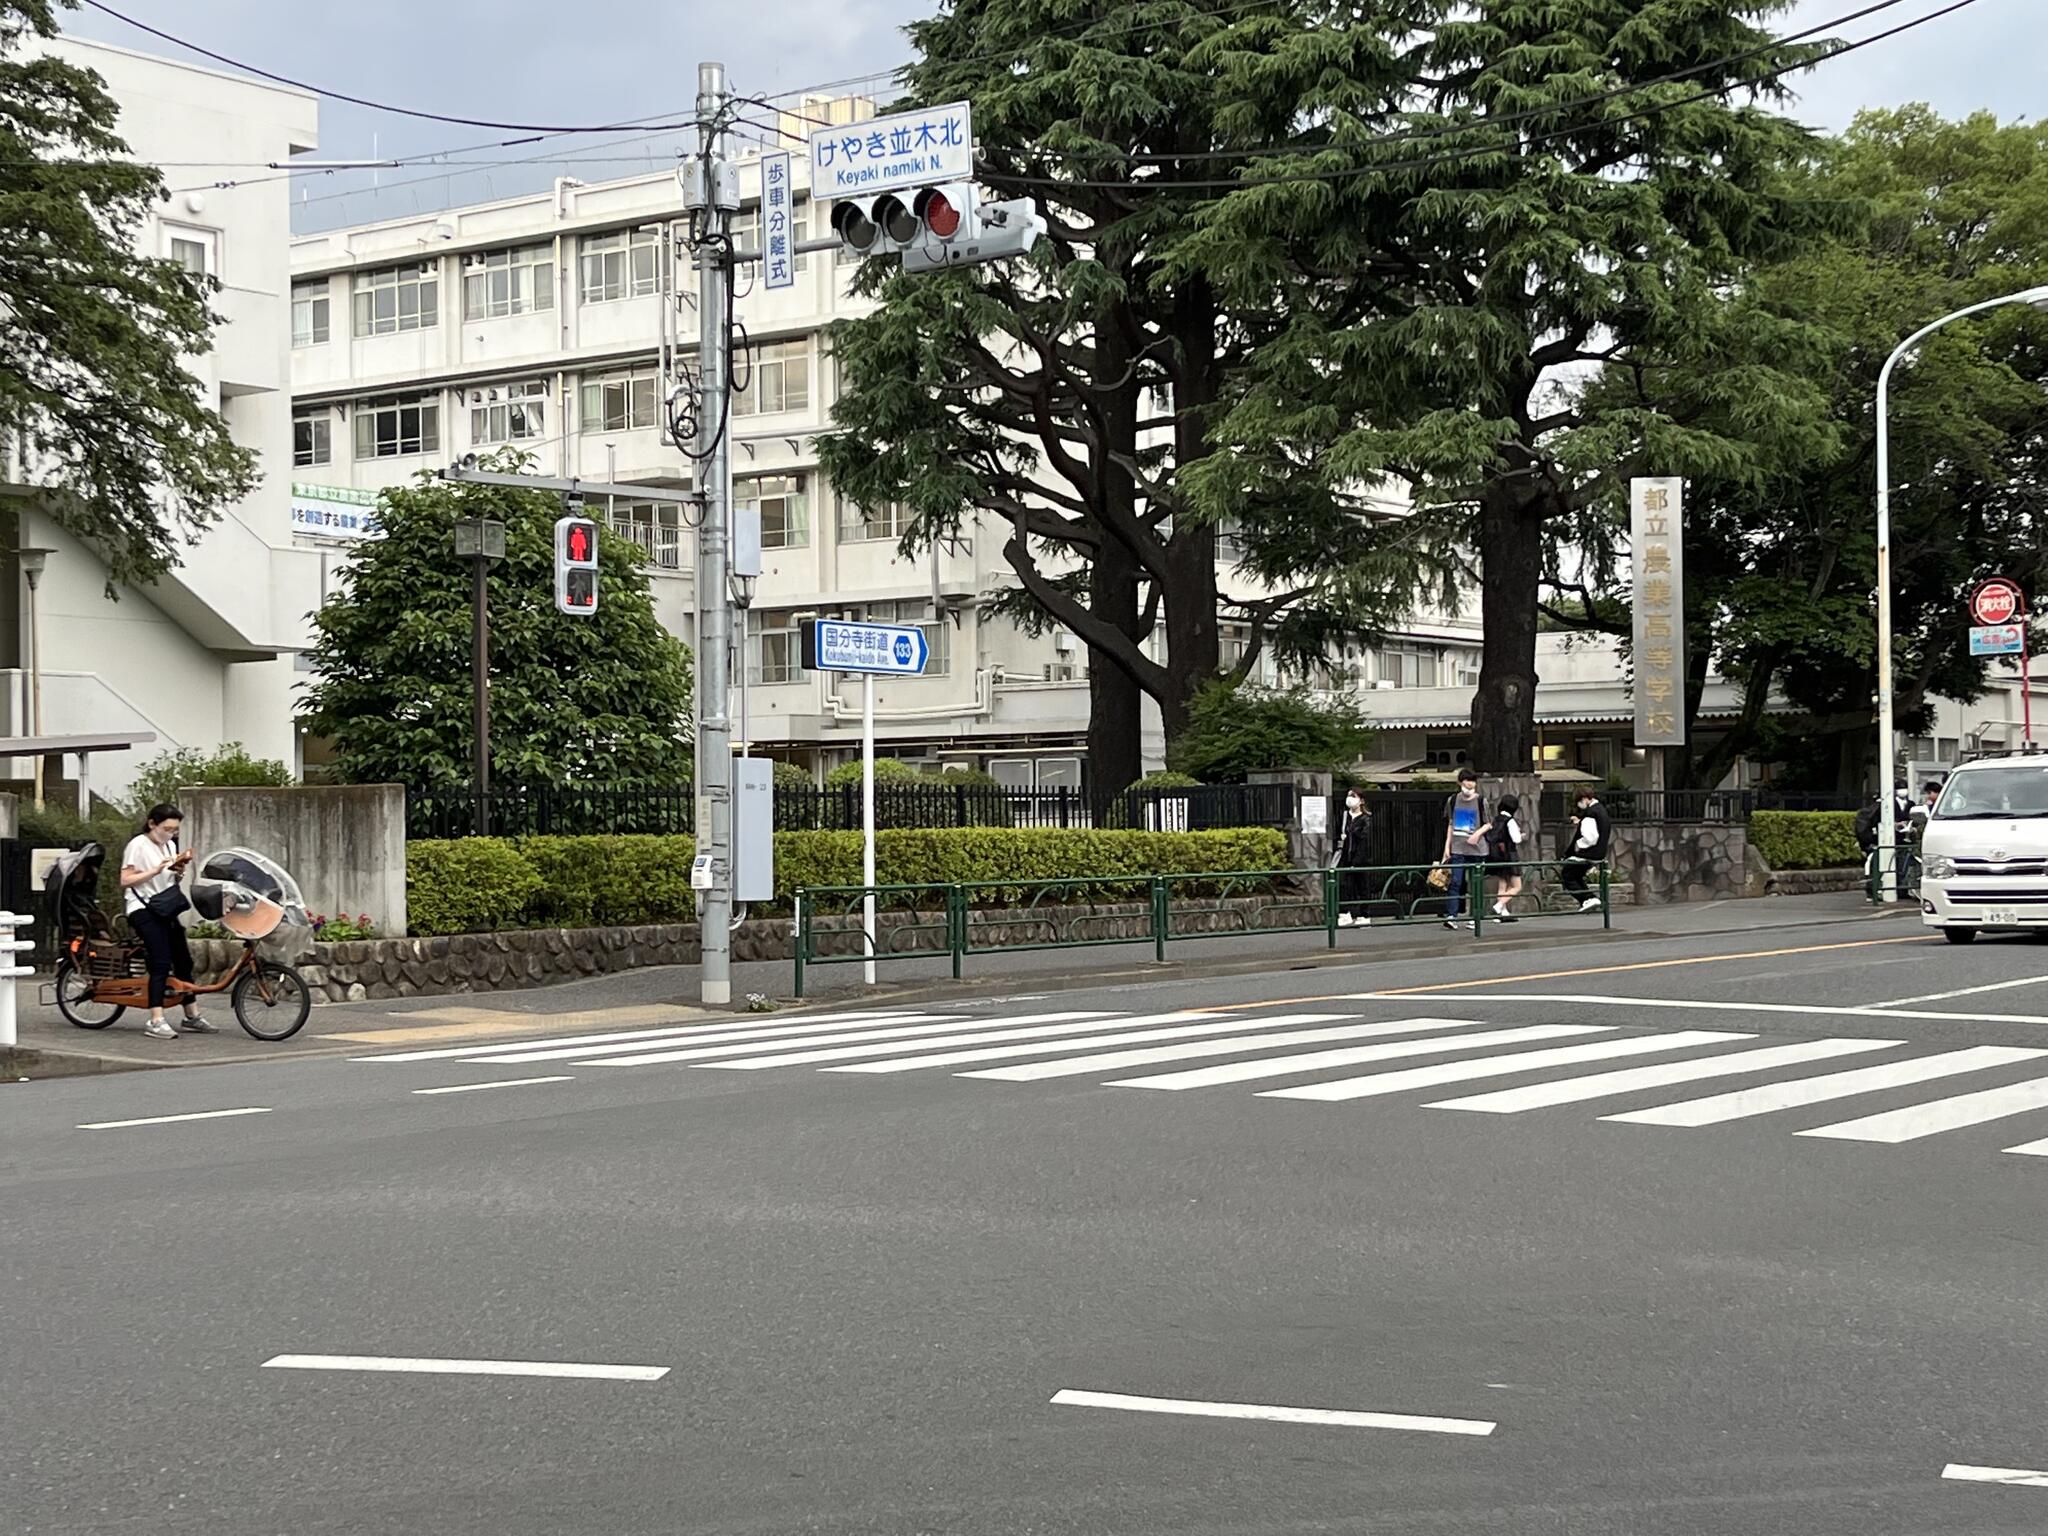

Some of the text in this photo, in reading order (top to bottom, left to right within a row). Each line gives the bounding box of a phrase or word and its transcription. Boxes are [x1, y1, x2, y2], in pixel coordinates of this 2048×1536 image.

[817, 117, 963, 168] けやき並木北
[836, 154, 943, 187] Keyaki namiki N.
[768, 163, 787, 280] 歩車分離式
[1643, 487, 1675, 735] 都立農業高等学校
[1980, 596, 2011, 613] 消火栓
[826, 627, 889, 651] 国分寺街道
[895, 642, 911, 658] 133
